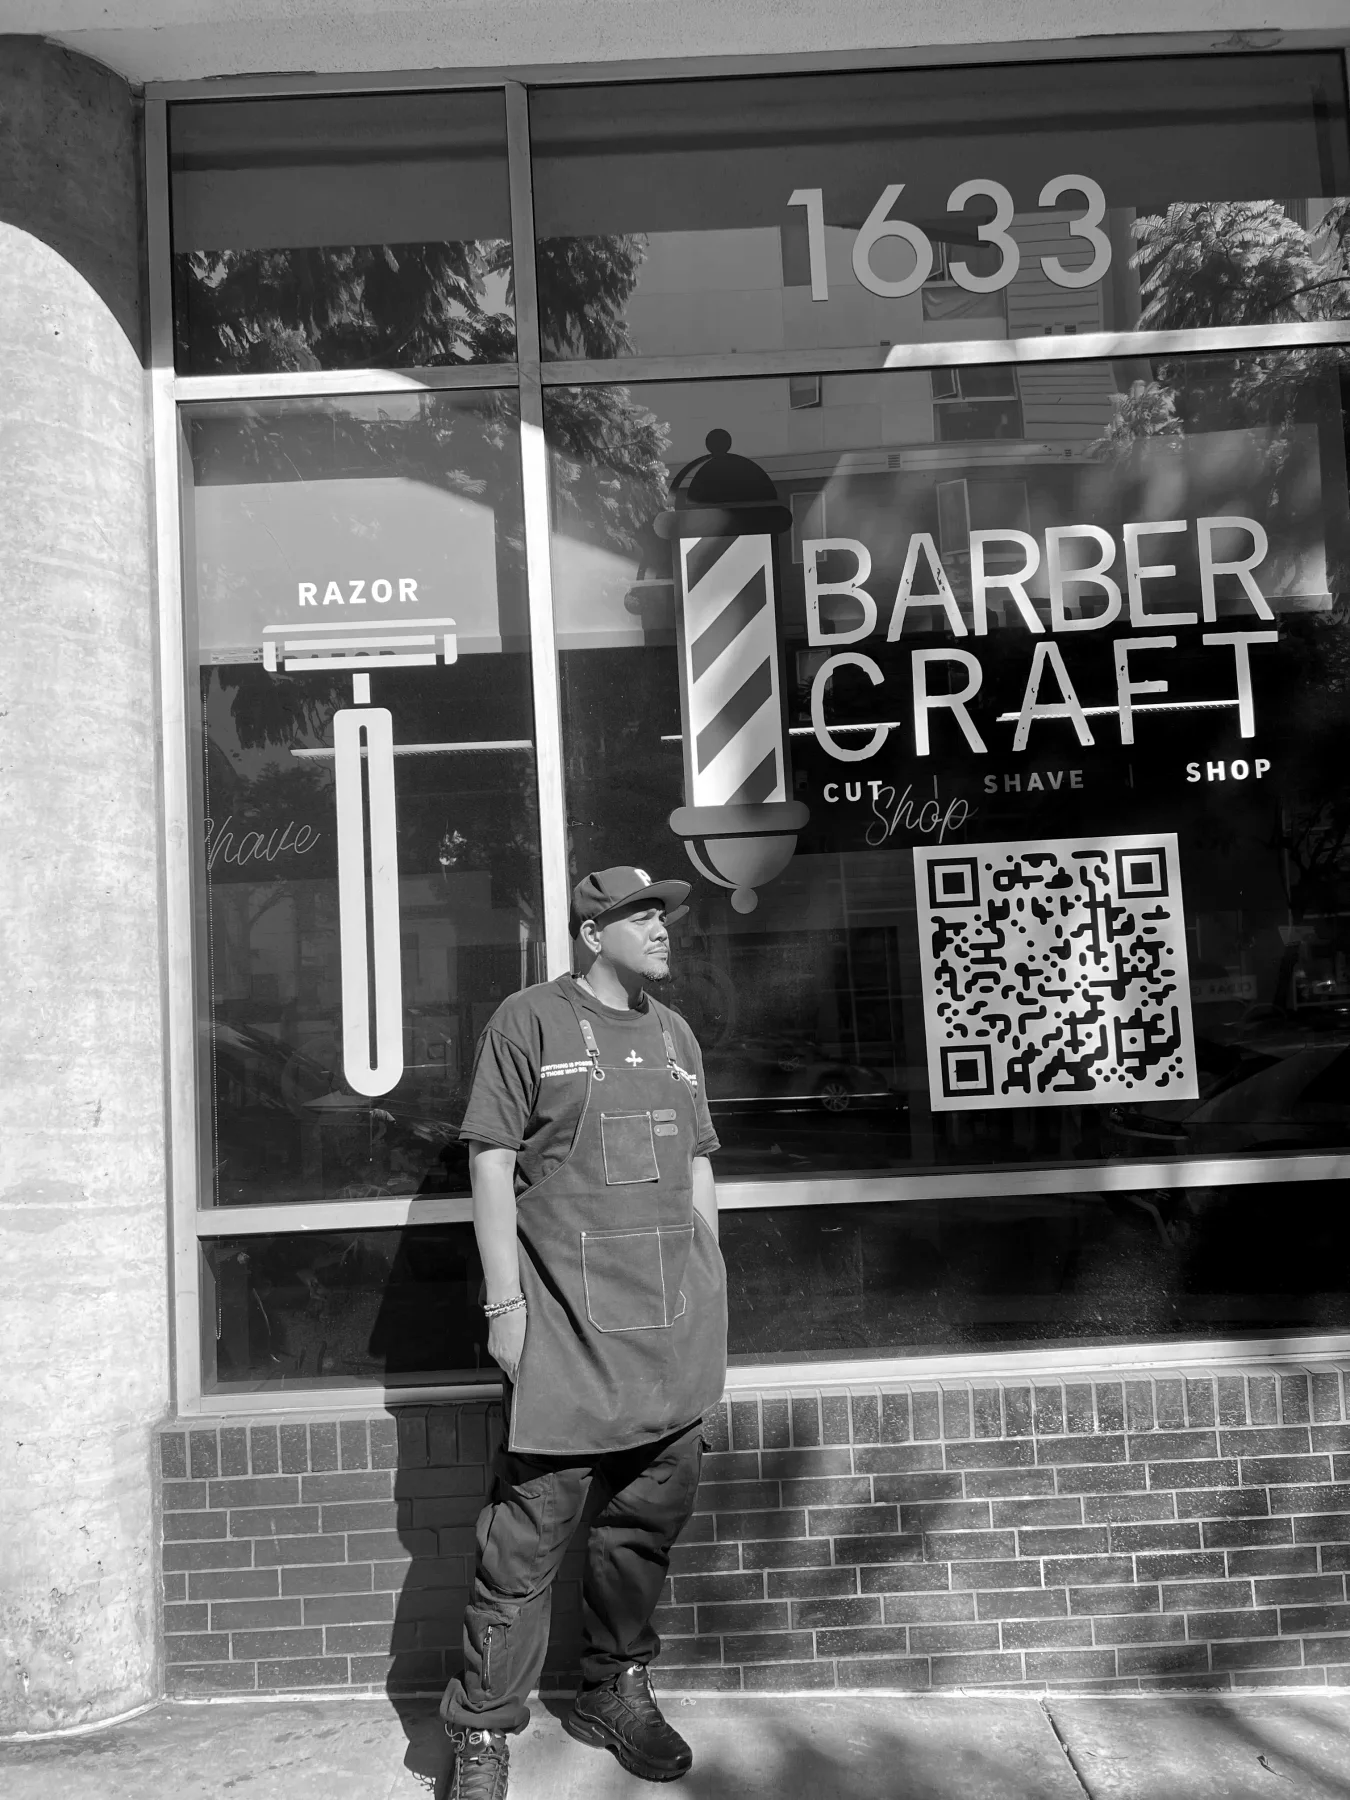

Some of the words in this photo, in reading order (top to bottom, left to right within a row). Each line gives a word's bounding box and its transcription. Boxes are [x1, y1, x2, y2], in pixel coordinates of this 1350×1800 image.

[787, 174, 1112, 302] 1633
[298, 577, 419, 606] RAZOR
[802, 516, 1275, 647] BARBER
[811, 631, 1278, 762] CRAFT
[823, 780, 883, 803] CUT
[983, 769, 1085, 794] SHAVE
[1186, 758, 1272, 783] SHOP
[865, 783, 979, 846] Shop
